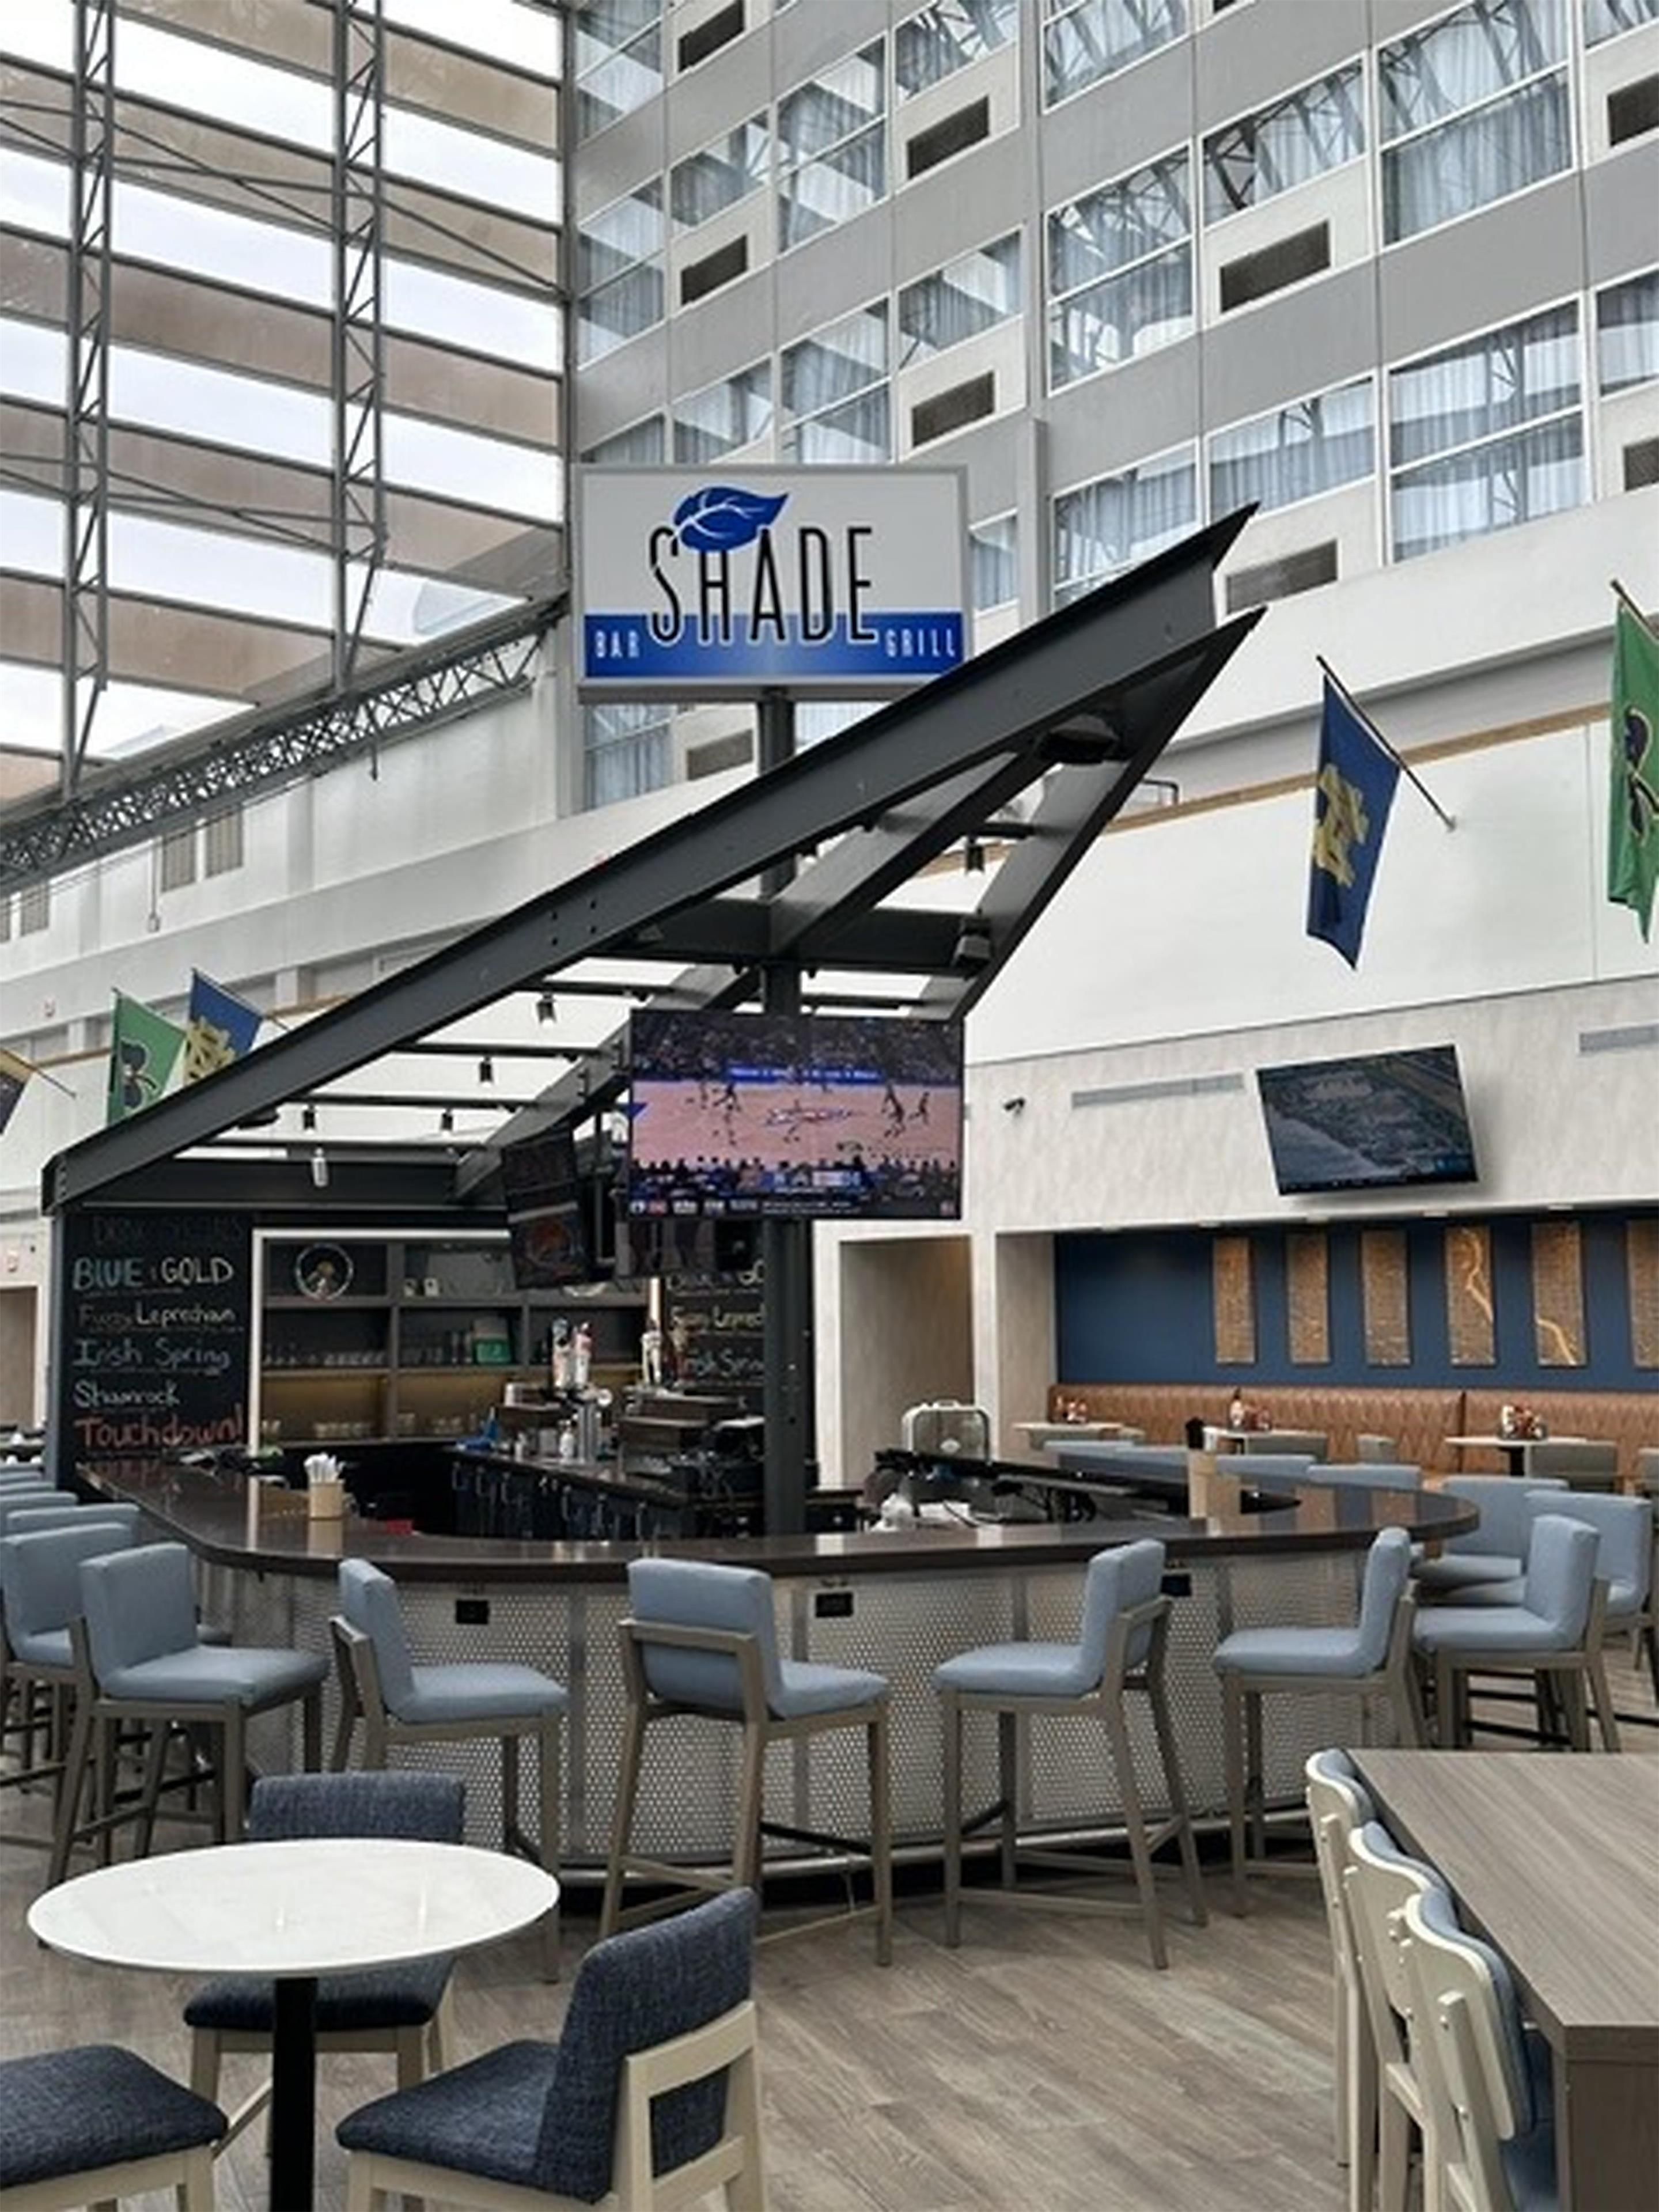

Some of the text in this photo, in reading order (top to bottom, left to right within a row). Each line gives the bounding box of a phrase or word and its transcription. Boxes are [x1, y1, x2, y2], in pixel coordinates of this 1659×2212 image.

[649, 527, 878, 643] SHADE
[595, 630, 639, 659] BAR
[885, 628, 955, 657] GRILL
[73, 1256, 144, 1291] BLUE
[161, 1256, 233, 1286] GOLD
[72, 1336, 230, 1370] Irish Spring
